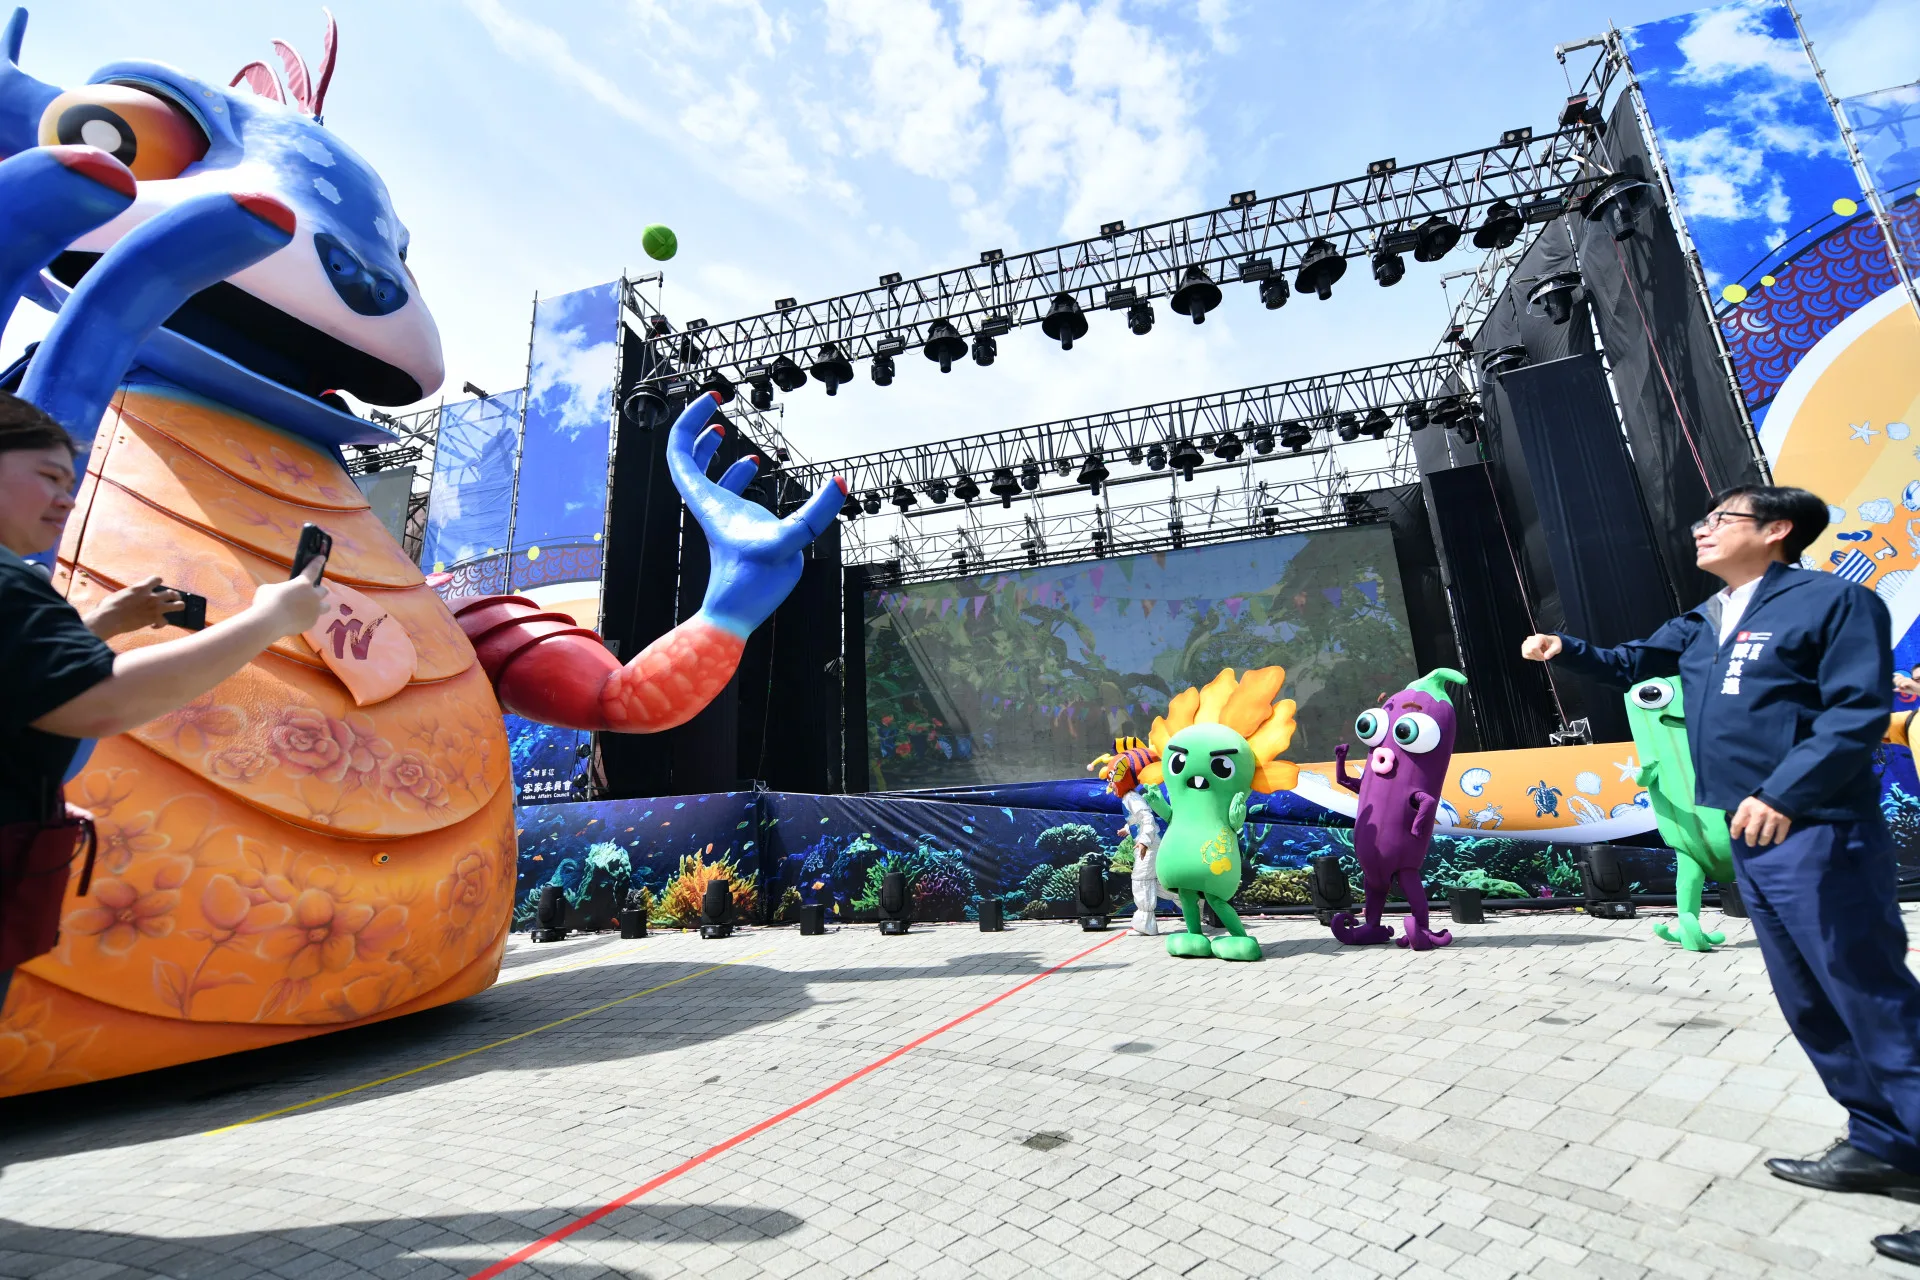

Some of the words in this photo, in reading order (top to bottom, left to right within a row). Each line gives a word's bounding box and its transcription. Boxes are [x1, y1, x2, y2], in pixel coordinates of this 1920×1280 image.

[523, 780, 572, 793] 客家委員會
